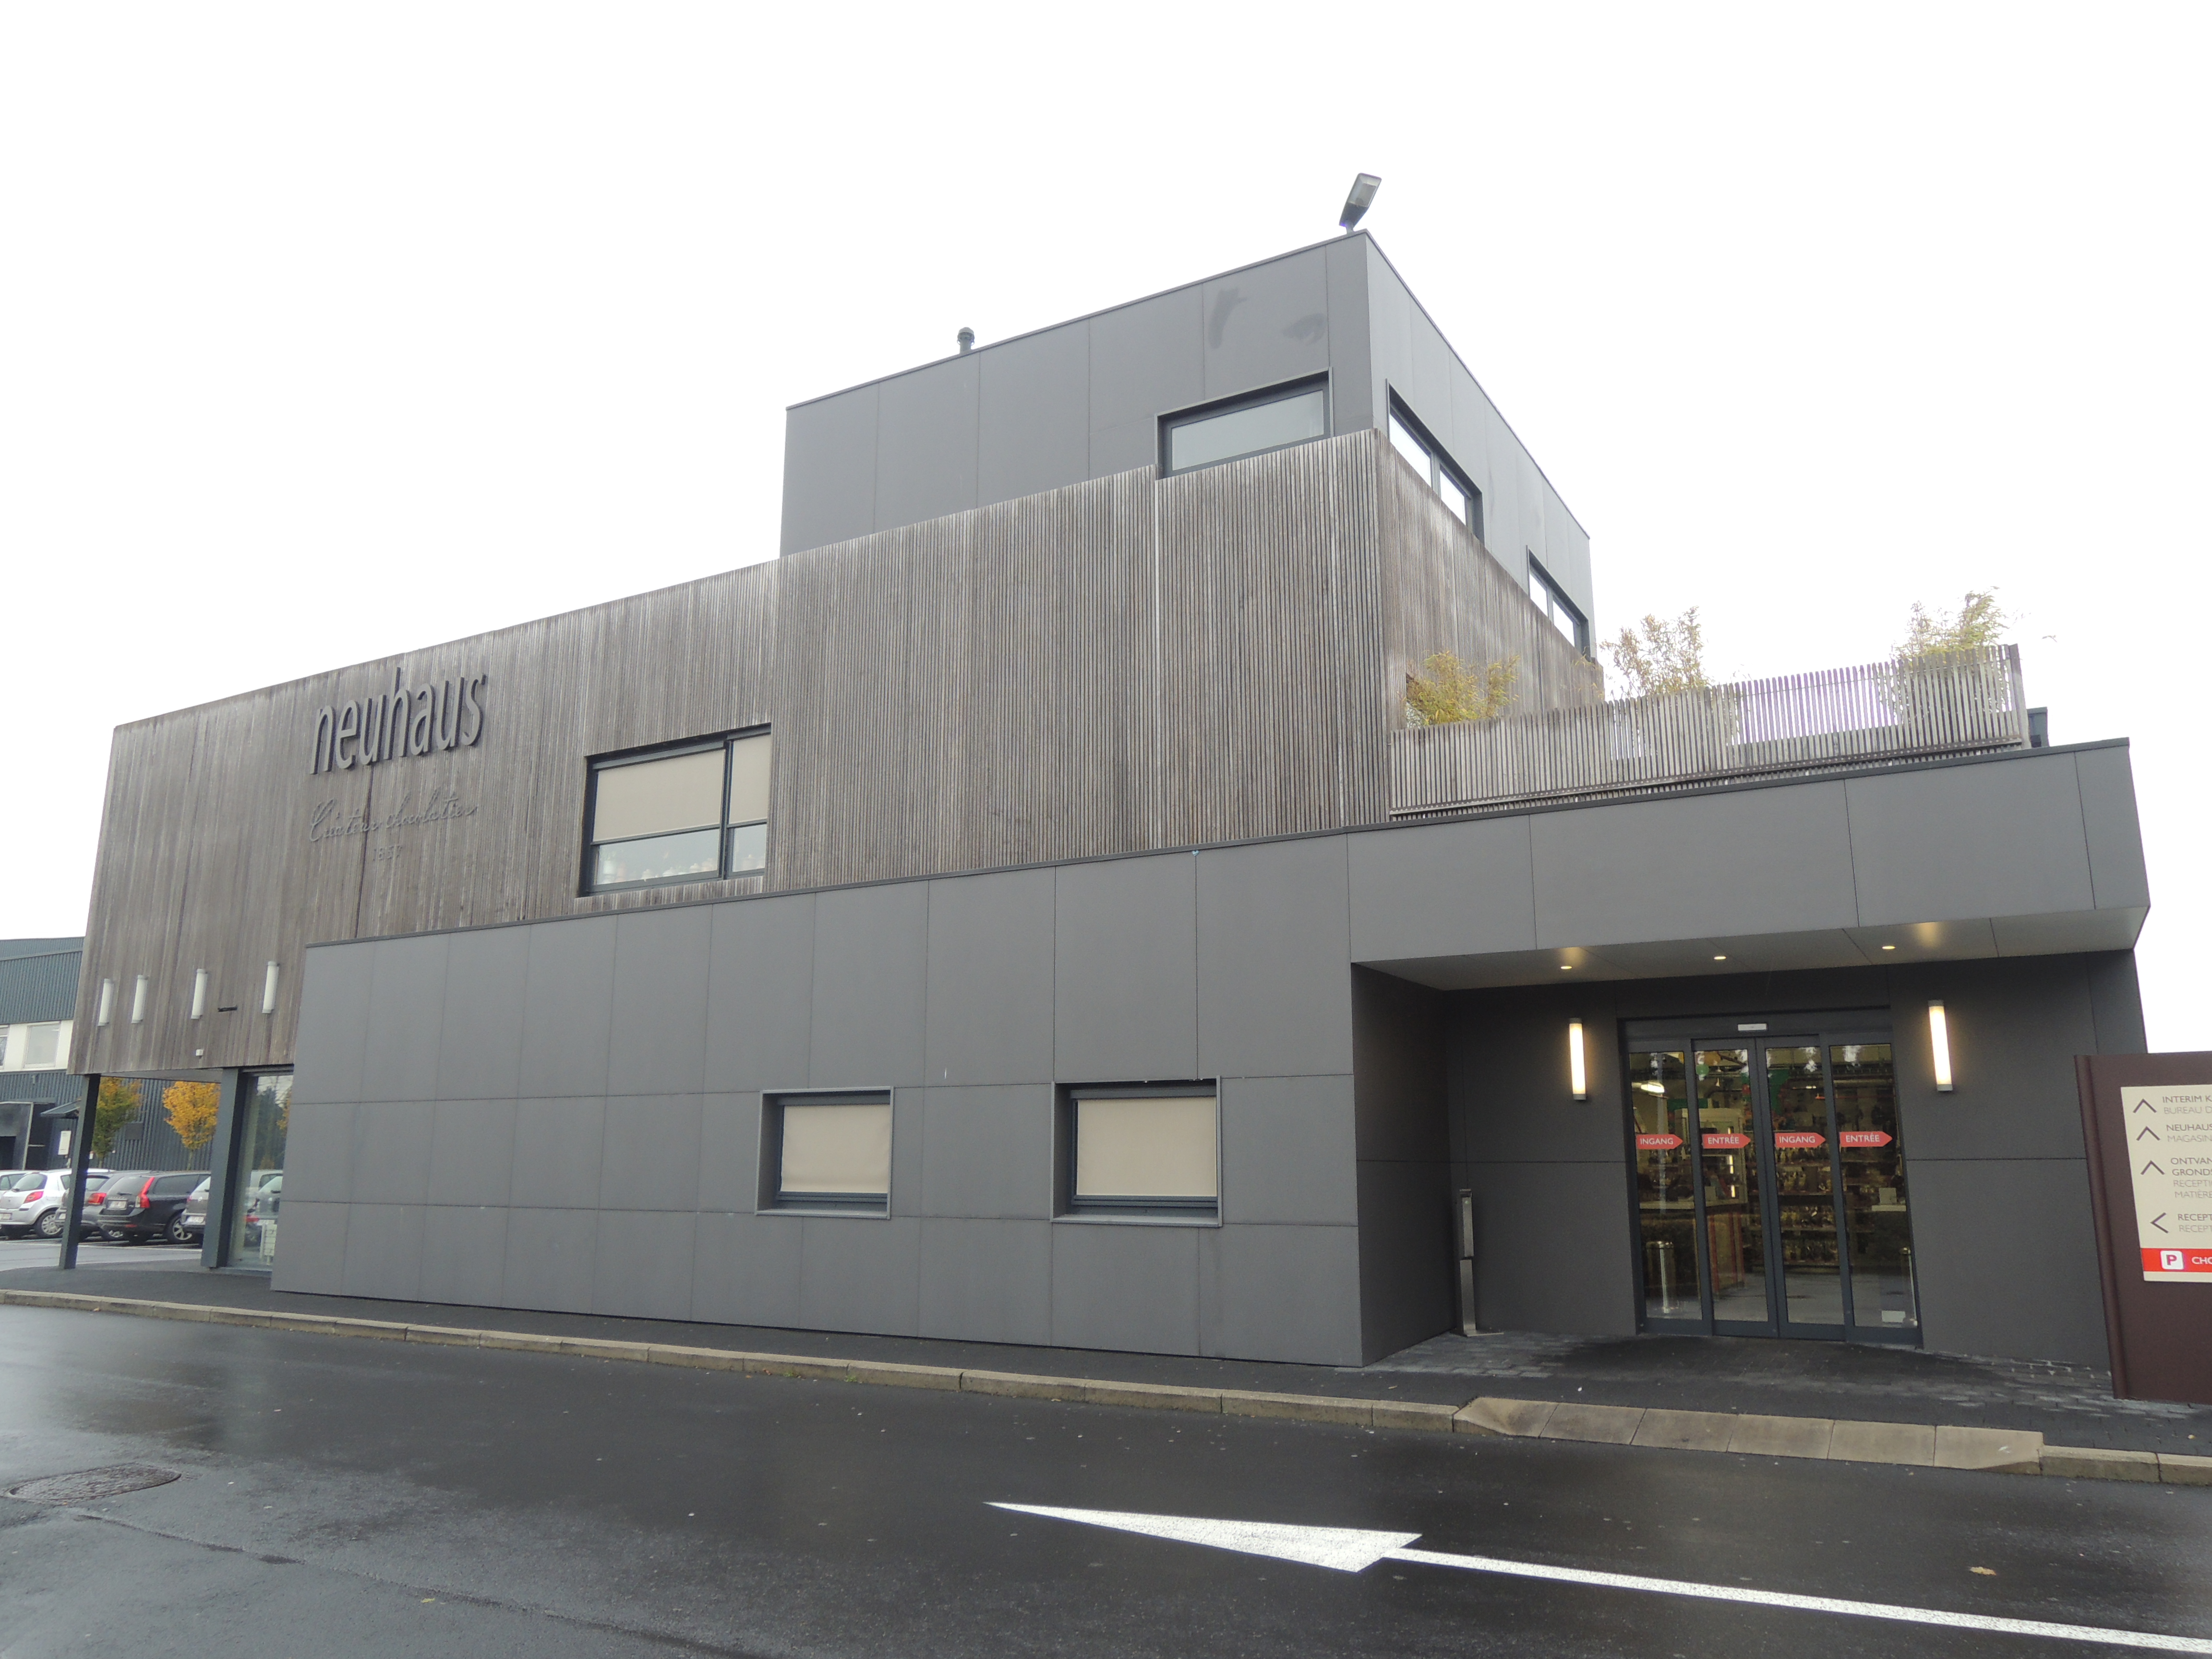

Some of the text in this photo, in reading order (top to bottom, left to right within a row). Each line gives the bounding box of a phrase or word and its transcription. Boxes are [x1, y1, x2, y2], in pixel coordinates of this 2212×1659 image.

[310, 667, 486, 775] neuhaus
[2166, 1123, 2212, 1131] NEUHAUS
[1640, 1137, 1674, 1145] INGANG
[1707, 1135, 1739, 1144] ENTRÉE
[1845, 1132, 1880, 1142] ENTRÉE
[2173, 1179, 2212, 1188] RECEPTI
[2175, 1189, 2212, 1199] MATIÈRE
[2165, 1254, 2178, 1266] P
